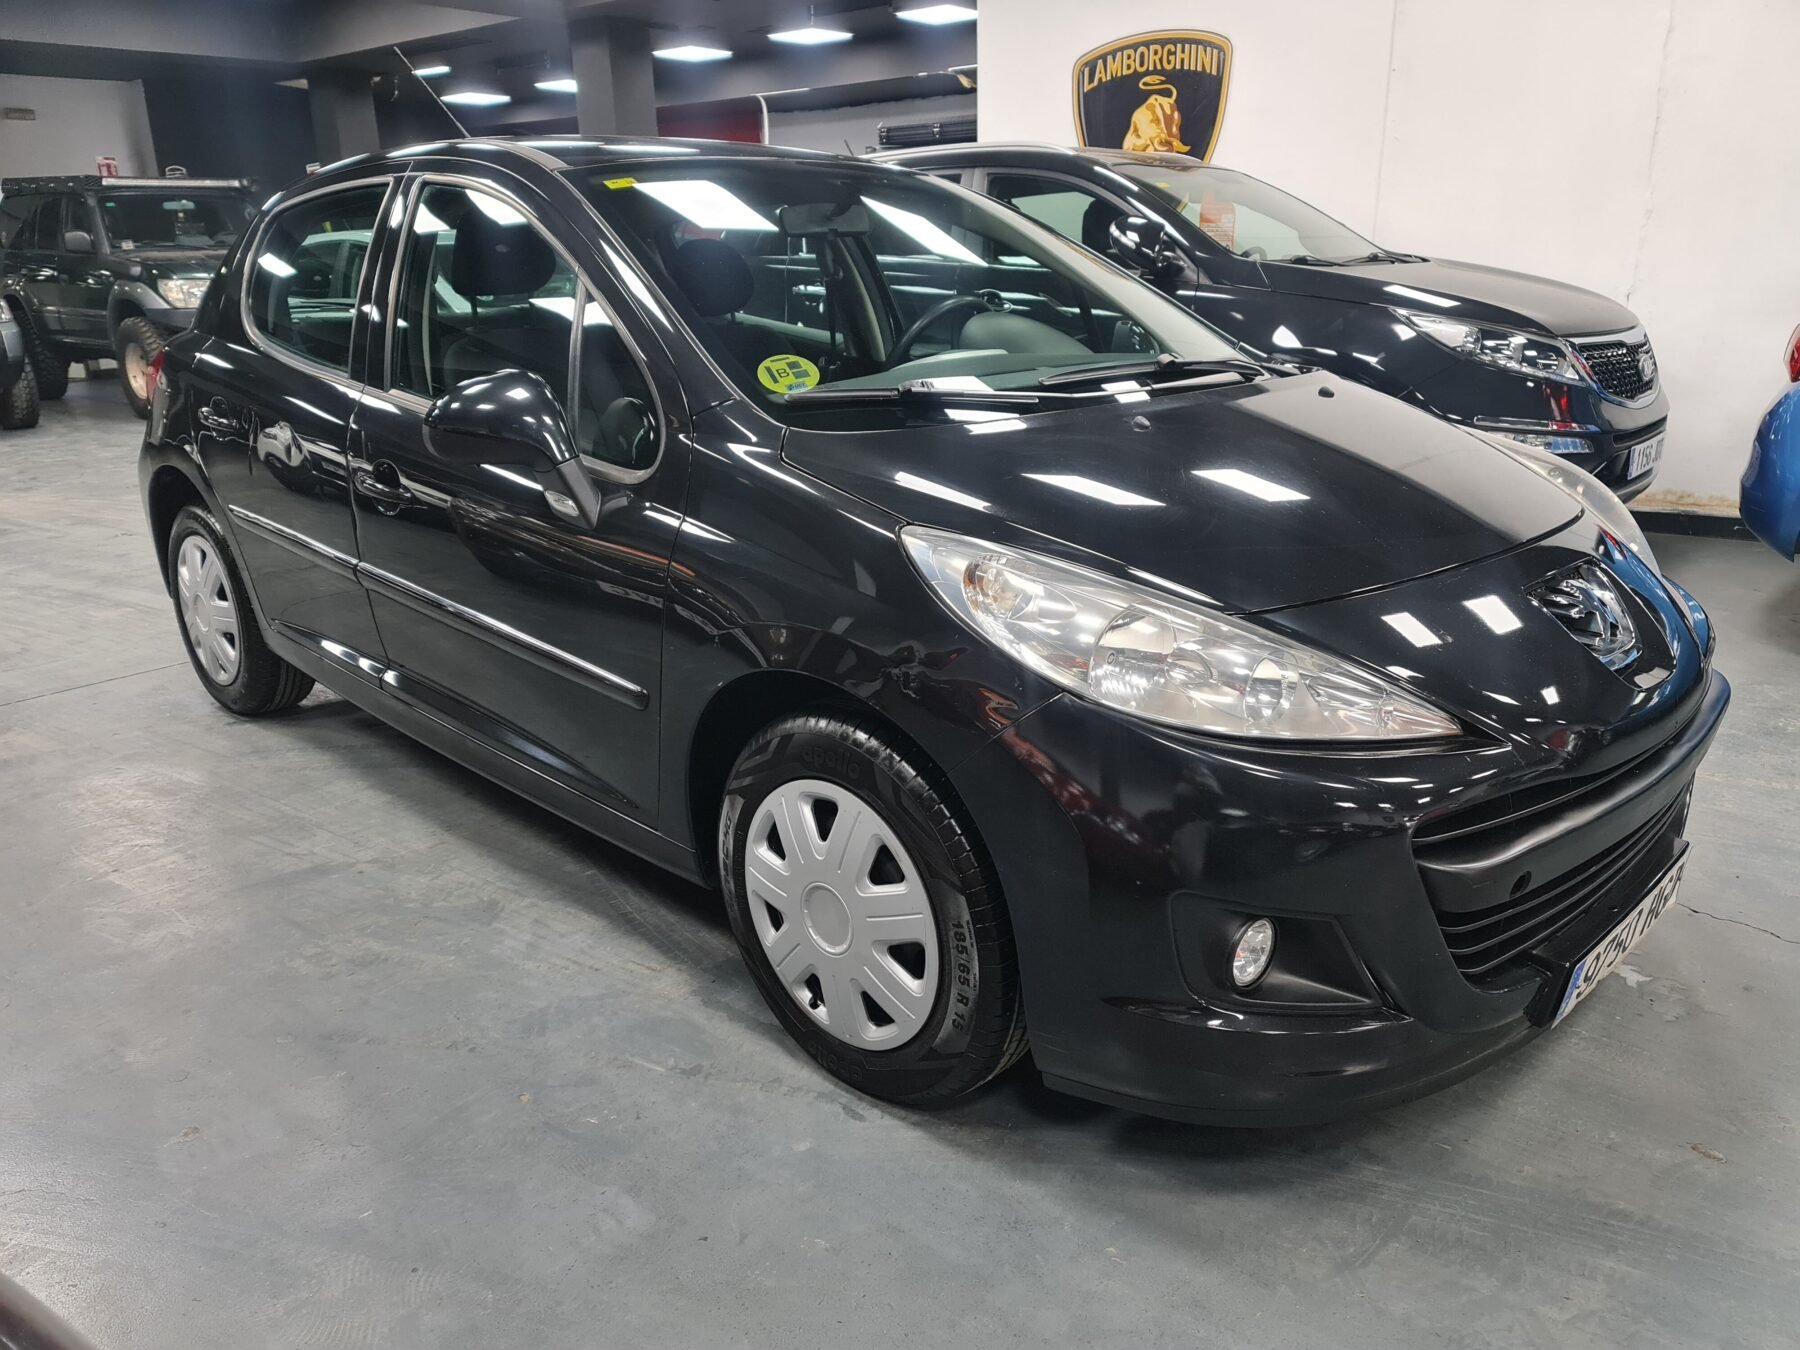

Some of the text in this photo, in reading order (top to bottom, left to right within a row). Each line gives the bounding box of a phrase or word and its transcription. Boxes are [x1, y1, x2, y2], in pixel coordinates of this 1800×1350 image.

[1083, 43, 1219, 93] LAMBORGHINI
[775, 368, 790, 379] B
[1636, 443, 1653, 472] 1156
[951, 920, 971, 988] 185/65
[1576, 907, 1644, 999] 9750
[956, 991, 970, 1007] R
[951, 1011, 966, 1031] 15
